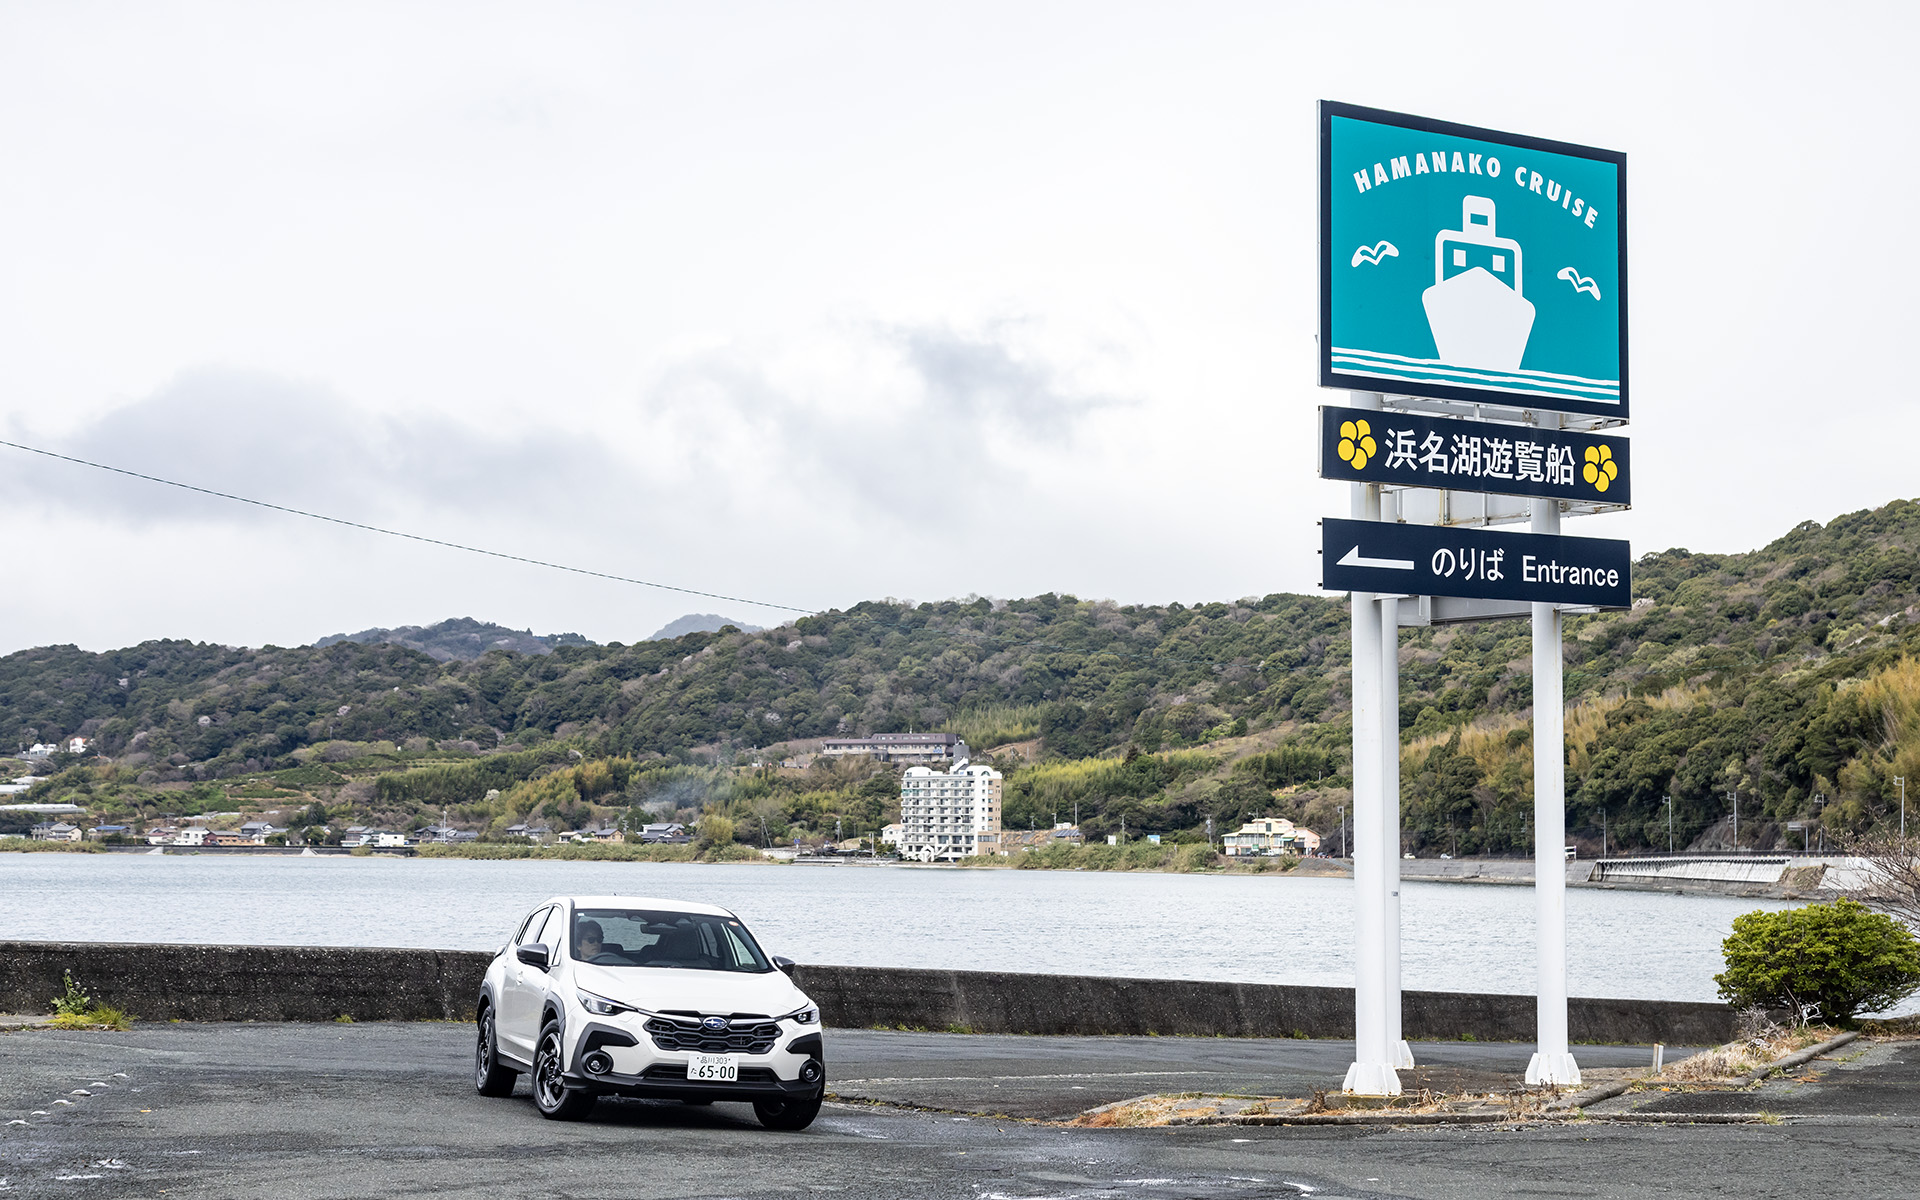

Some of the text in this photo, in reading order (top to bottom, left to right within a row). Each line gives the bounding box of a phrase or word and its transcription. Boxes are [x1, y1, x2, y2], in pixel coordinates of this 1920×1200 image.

[1353, 151, 1599, 229] HAMANAKO CRUISE
[1384, 428, 1576, 486] 浜名湖遊覧船
[1431, 547, 1619, 588] のりば Entrance
[698, 1065, 735, 1079] 65-00
